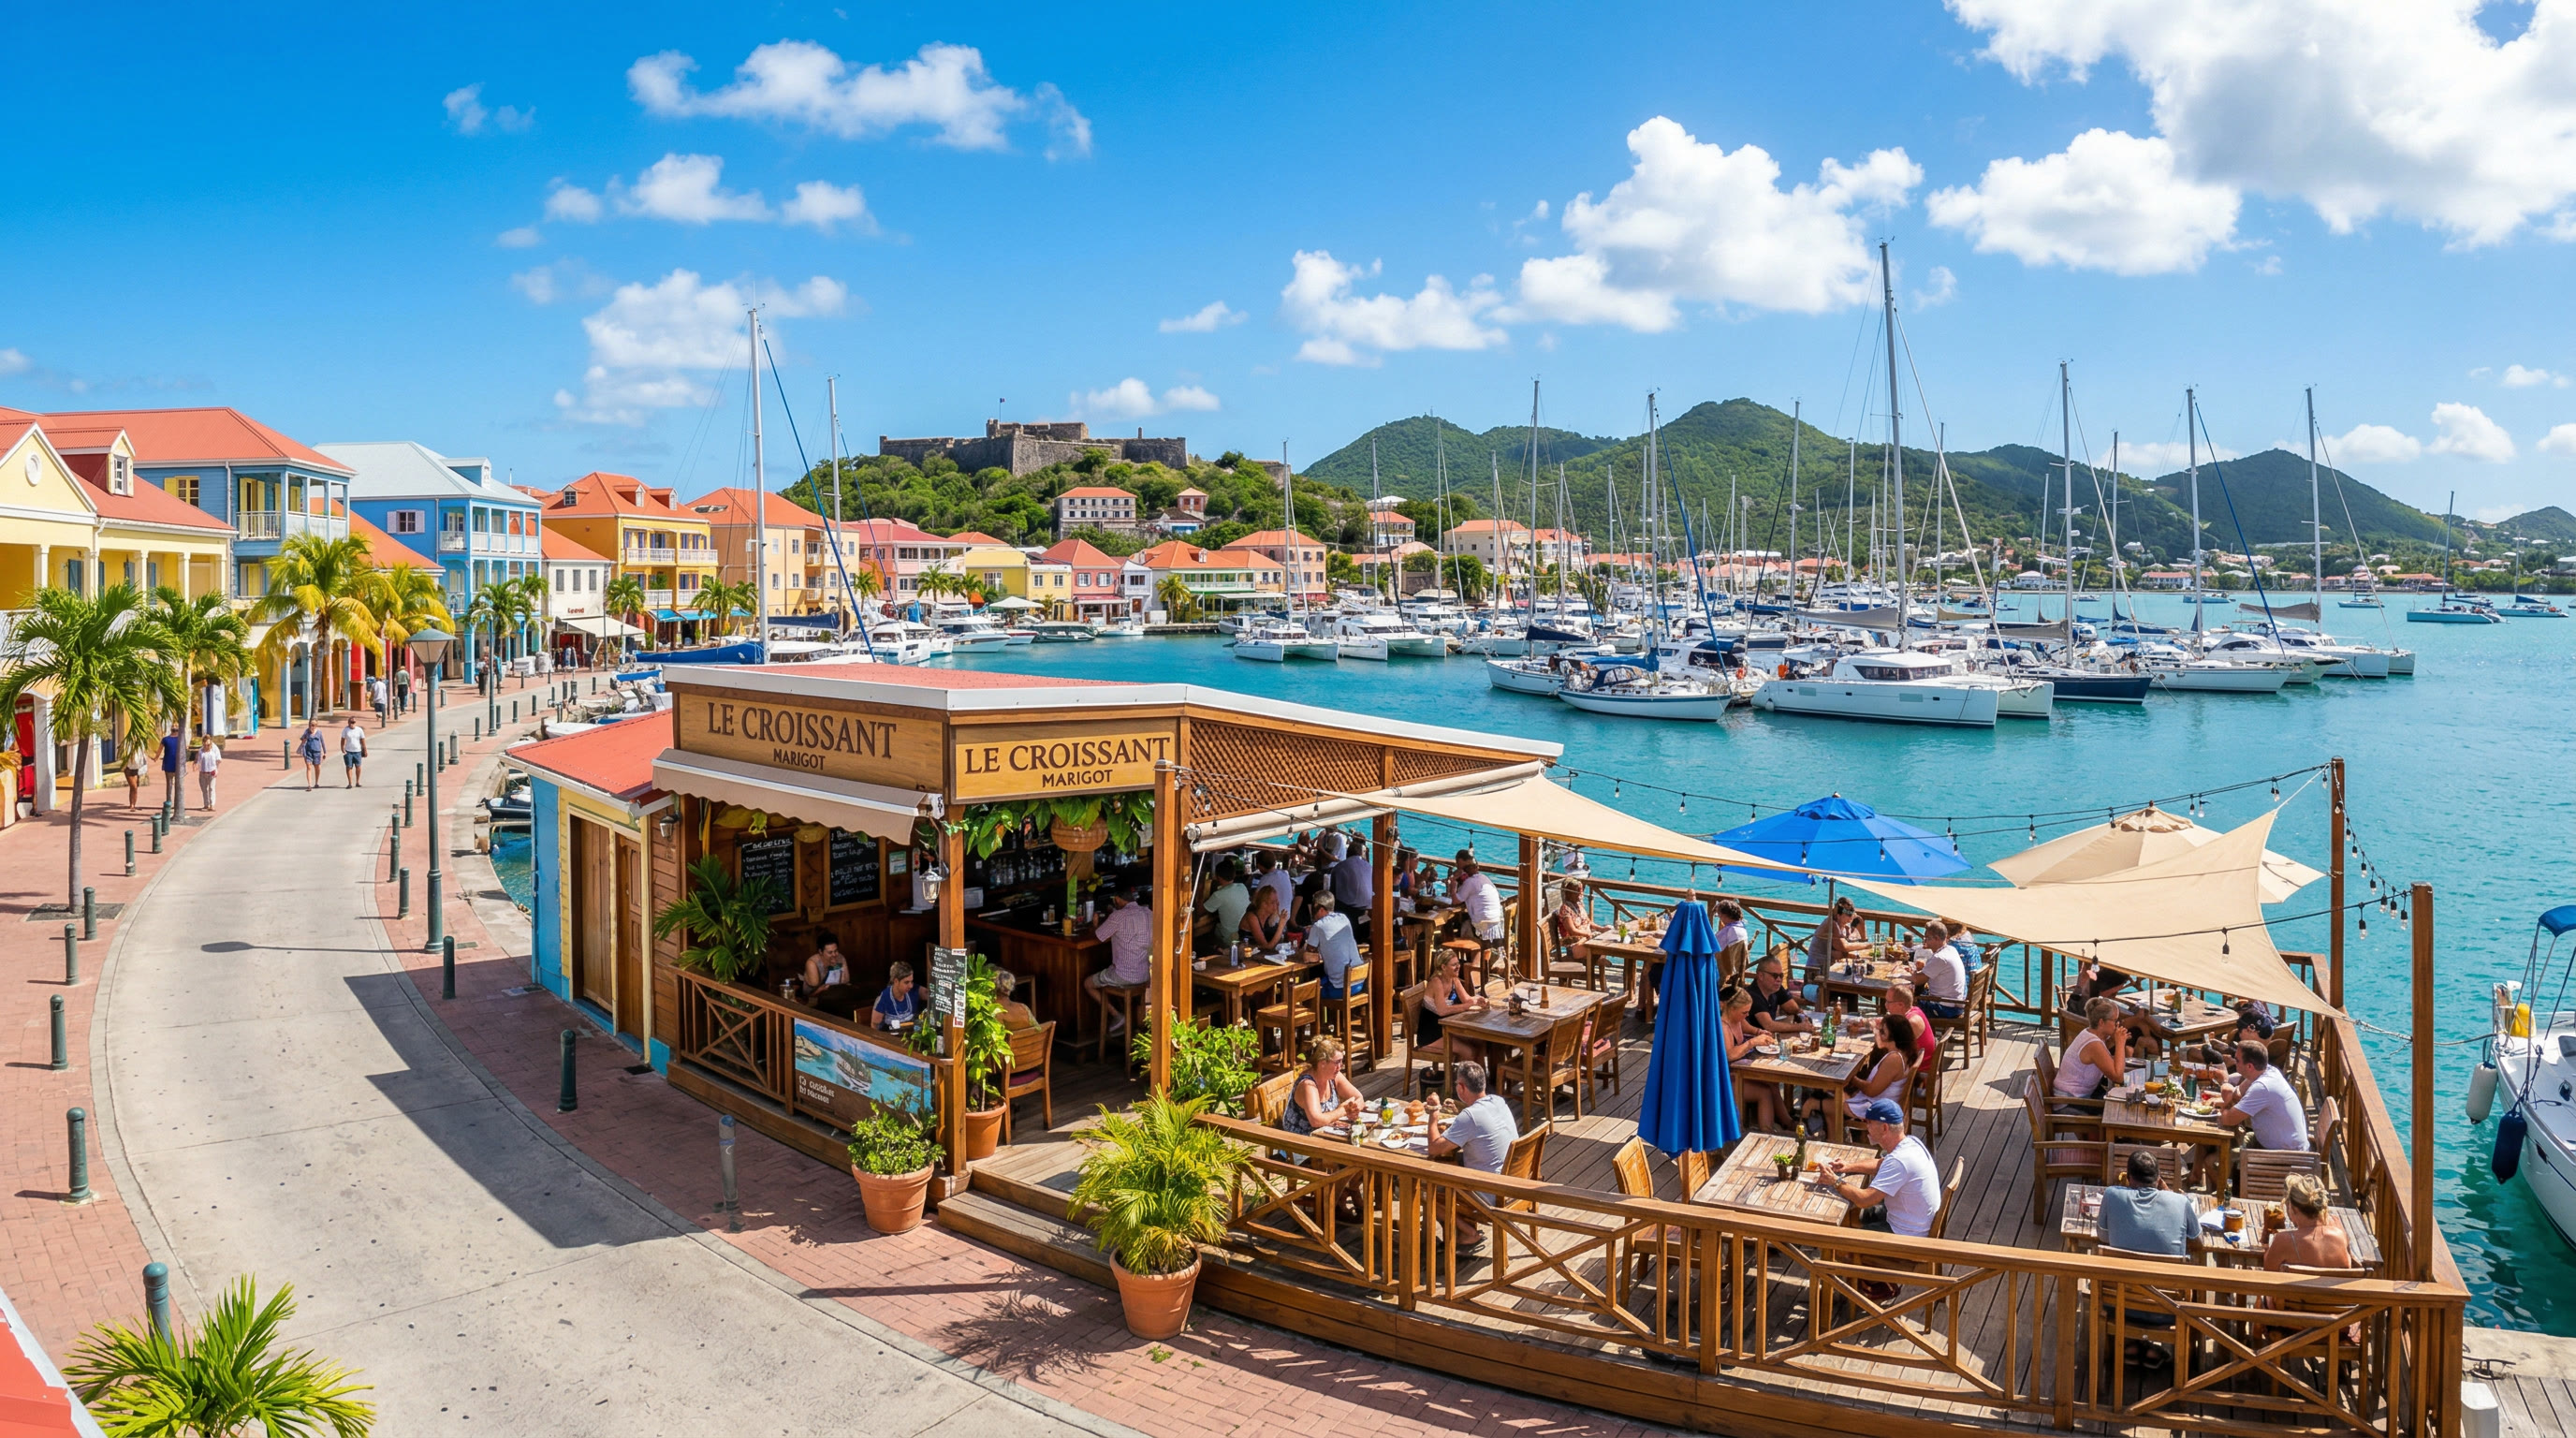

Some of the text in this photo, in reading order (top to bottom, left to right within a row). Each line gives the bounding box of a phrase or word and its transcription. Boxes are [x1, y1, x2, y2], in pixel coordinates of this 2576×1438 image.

[708, 702, 897, 759] LE CROISSANT
[773, 748, 826, 770] MARIGOT
[965, 736, 1171, 774] LE CROISSANT
[1042, 769, 1113, 788] MARIGOT
